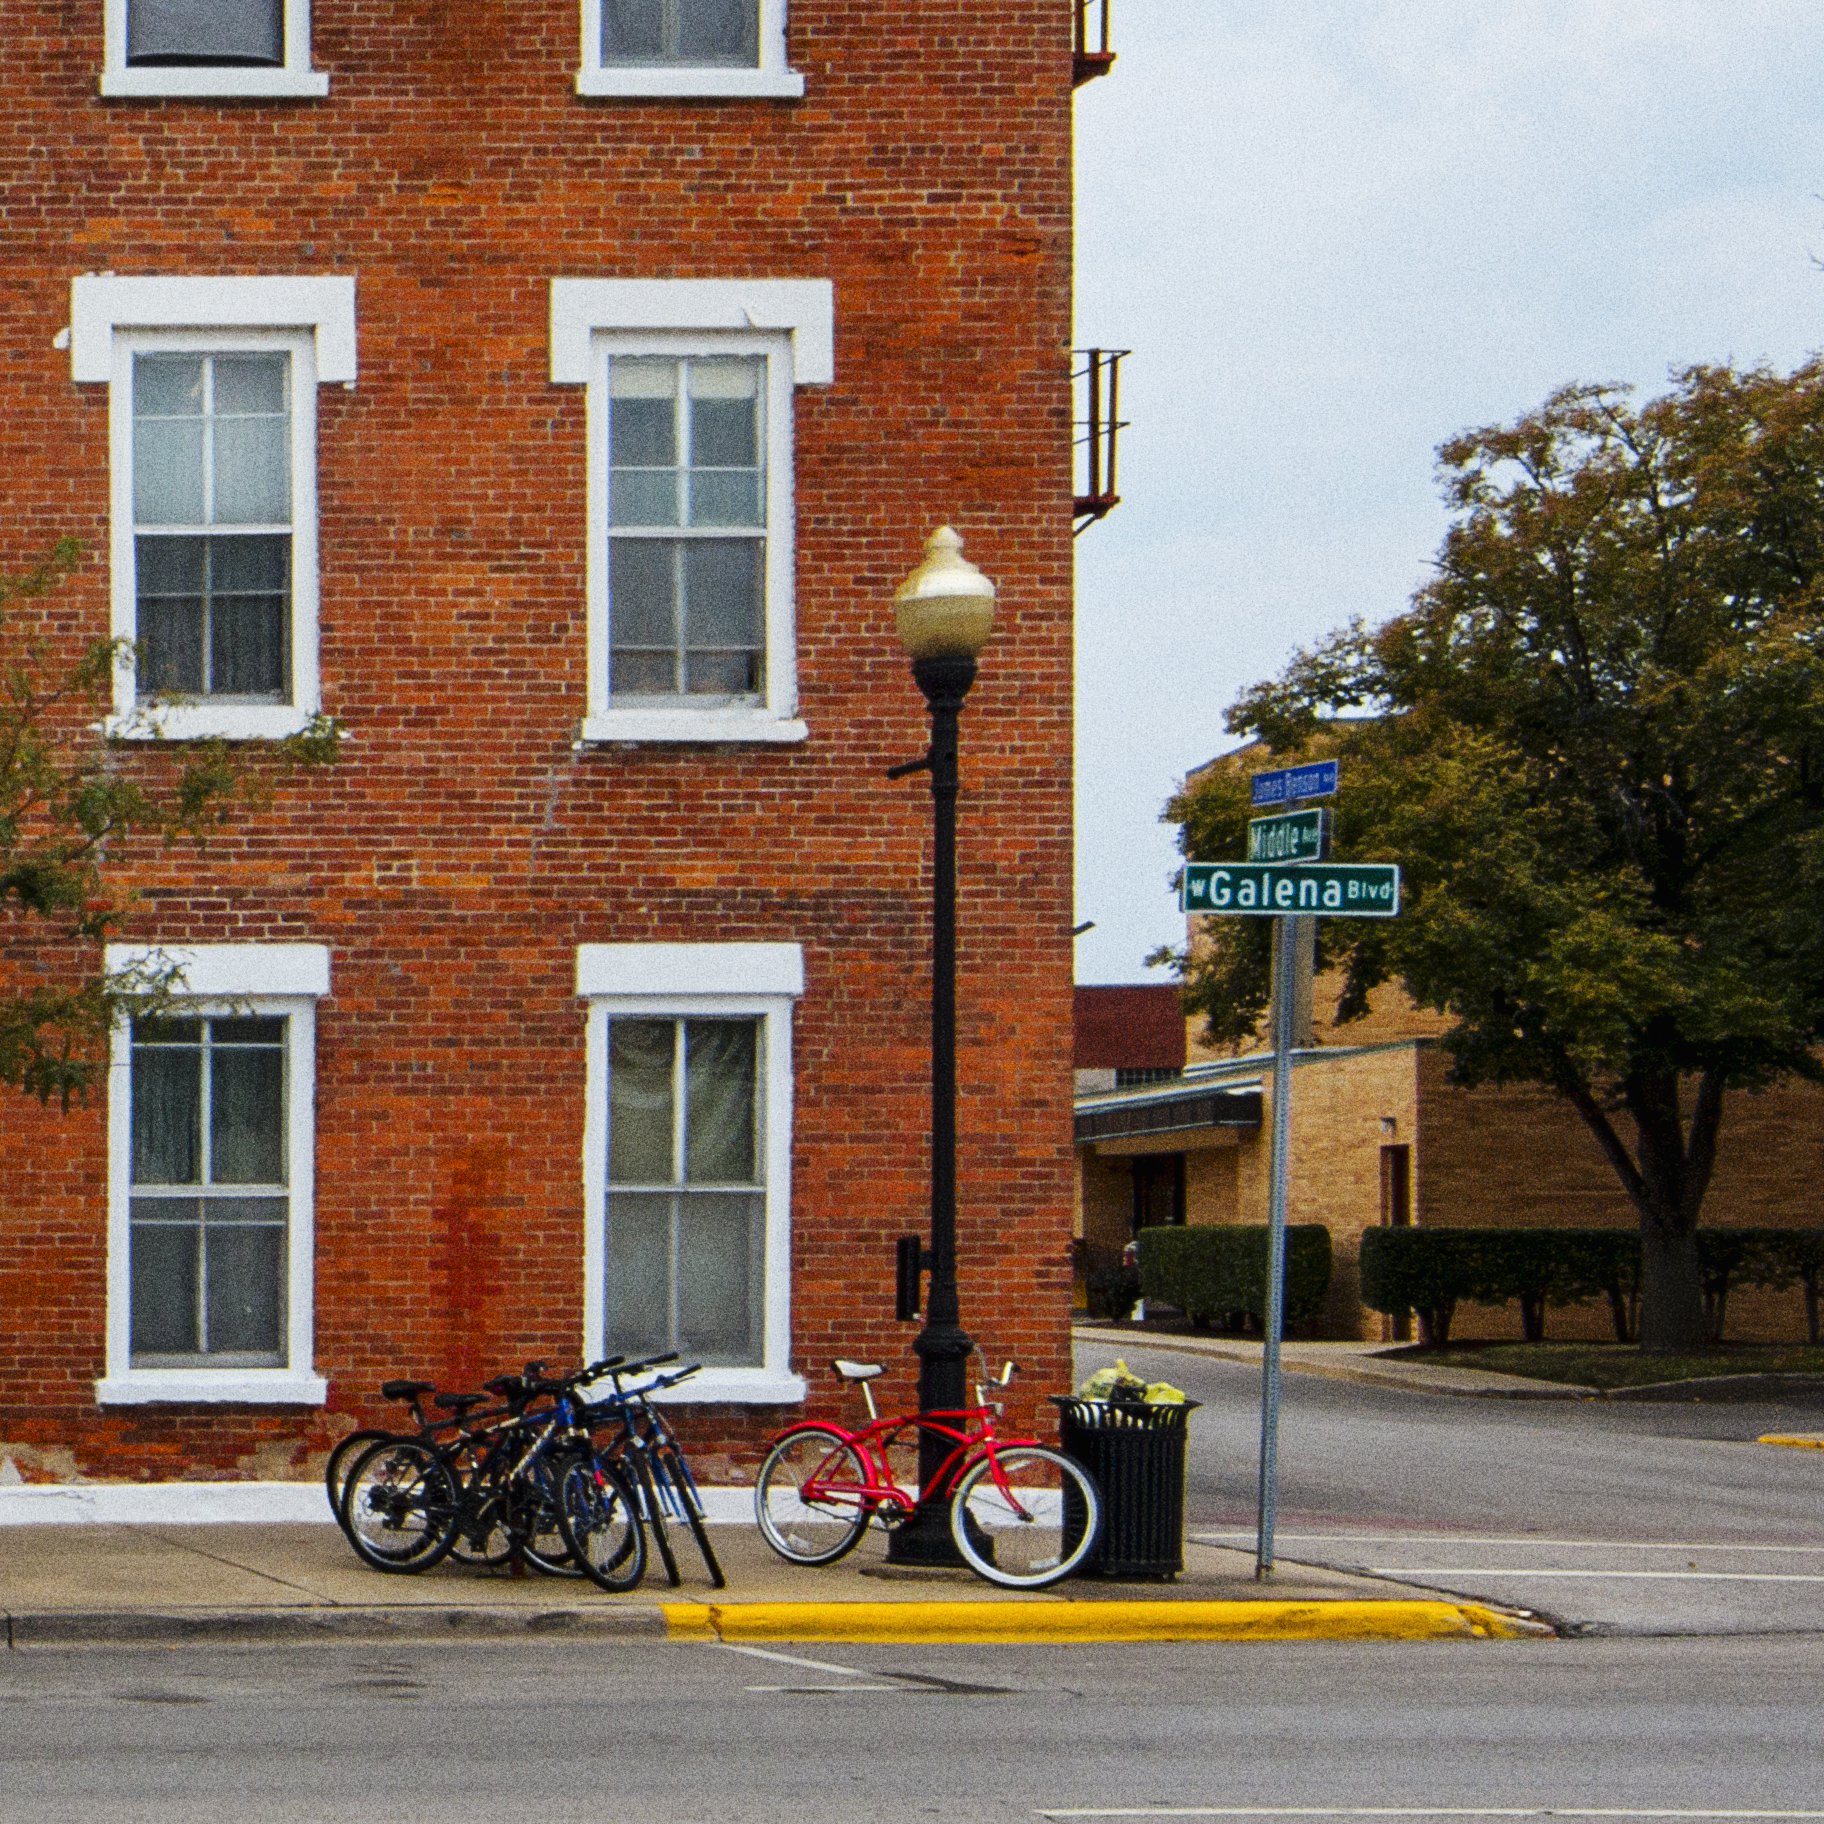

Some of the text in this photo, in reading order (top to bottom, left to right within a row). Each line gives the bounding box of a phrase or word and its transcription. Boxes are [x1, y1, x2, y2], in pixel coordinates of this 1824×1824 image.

[1250, 822, 1299, 860] Middle
[1190, 870, 1391, 907] W Galena Blvd
